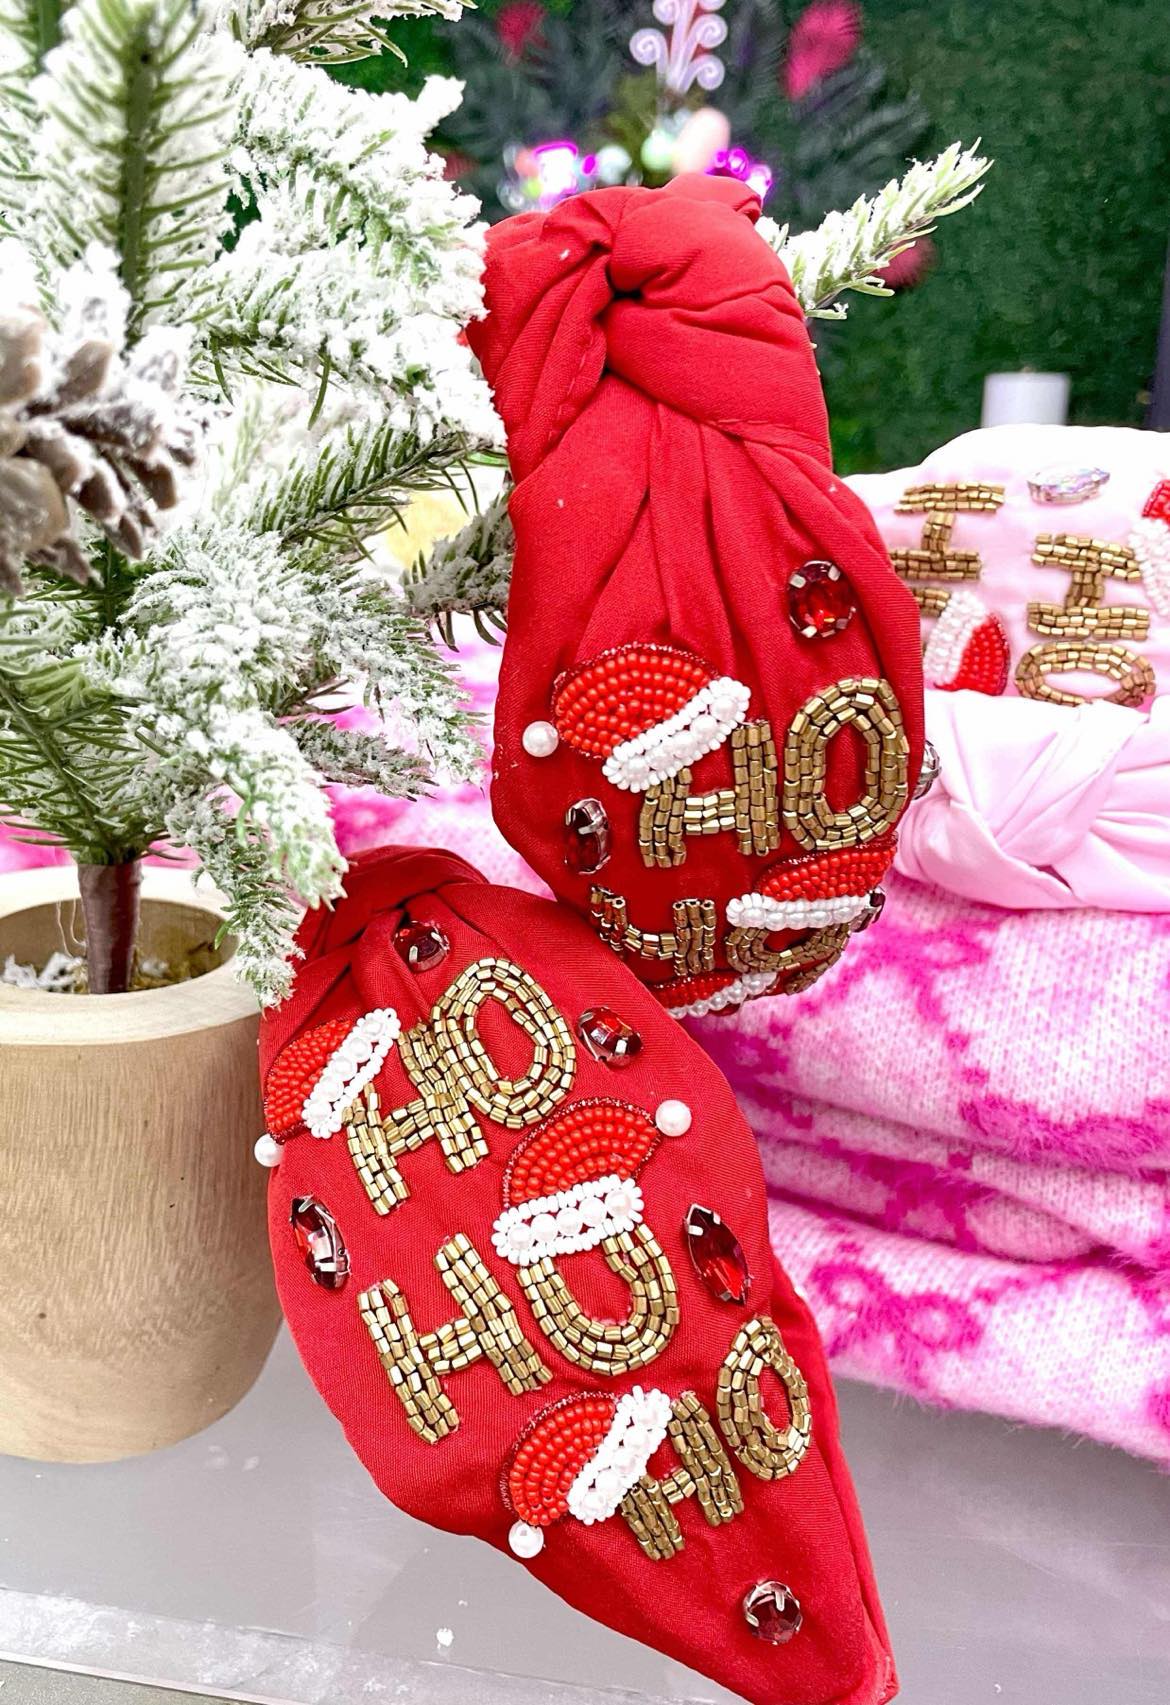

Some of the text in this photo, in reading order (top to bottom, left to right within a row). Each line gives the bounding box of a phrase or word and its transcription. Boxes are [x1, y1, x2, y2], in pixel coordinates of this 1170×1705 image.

[639, 676, 908, 868] HO
[342, 956, 578, 1216] HO
[622, 1315, 811, 1561] HO
